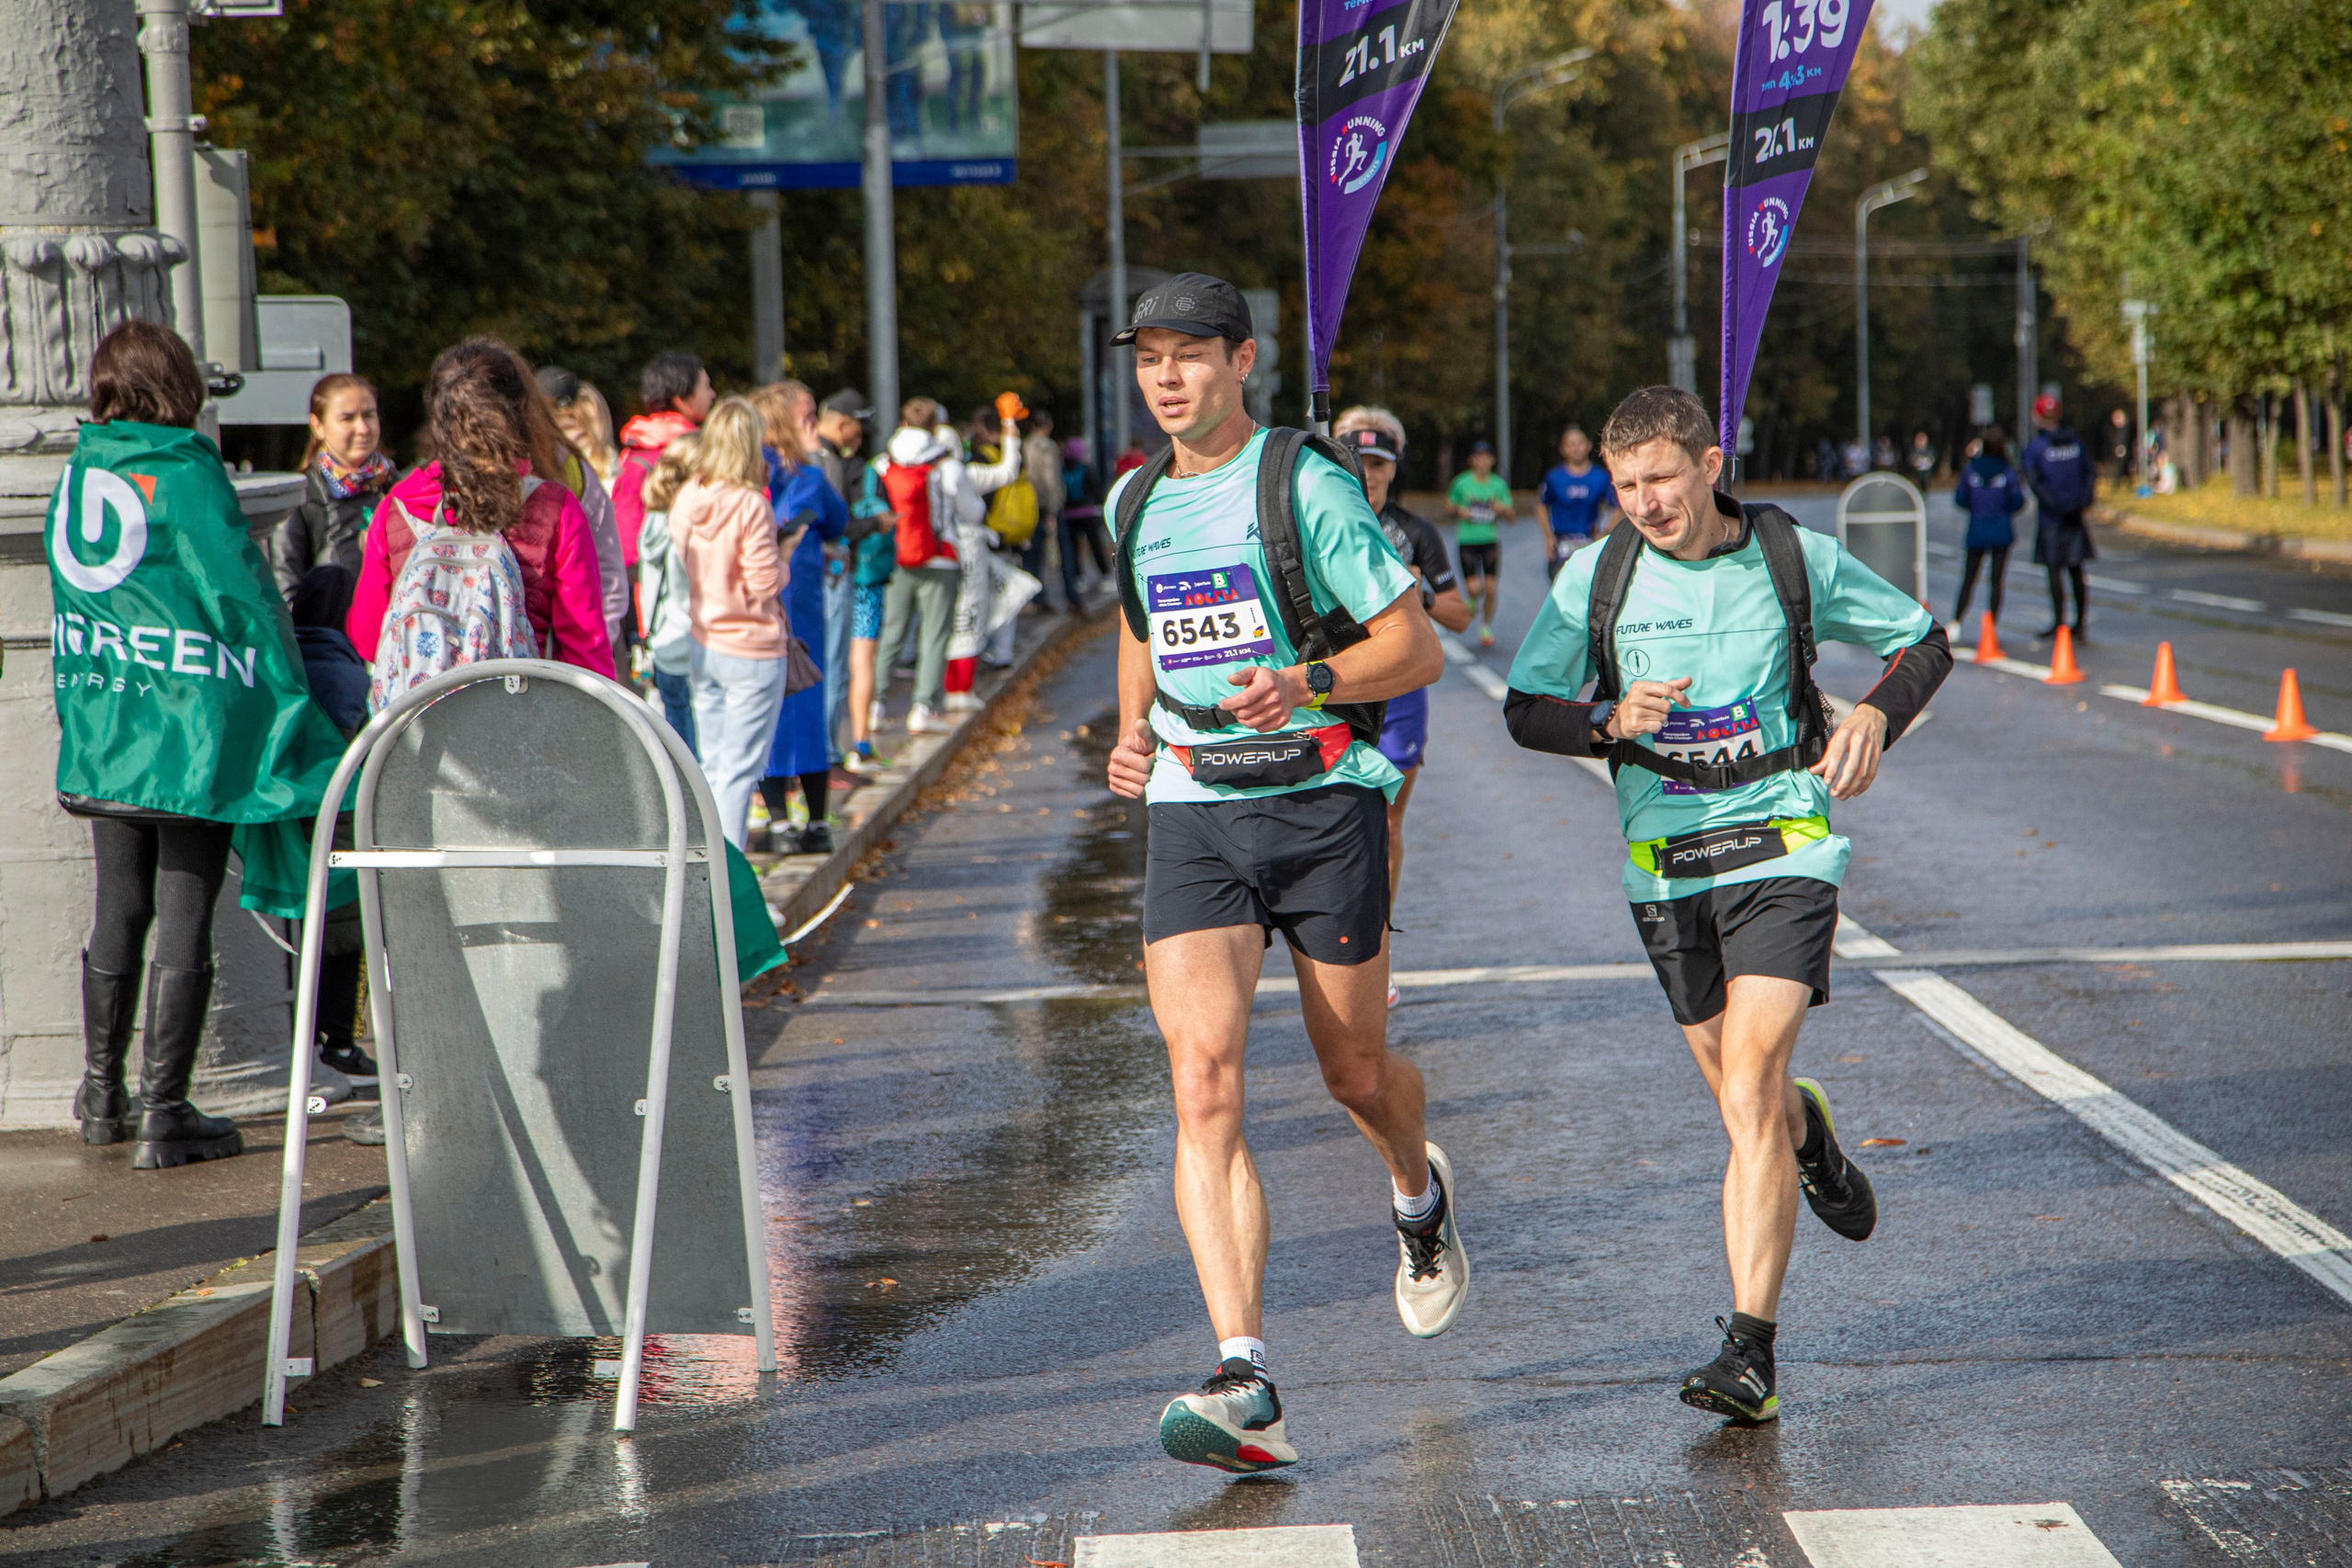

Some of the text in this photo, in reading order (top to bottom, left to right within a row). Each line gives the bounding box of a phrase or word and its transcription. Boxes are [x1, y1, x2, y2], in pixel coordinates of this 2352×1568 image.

[1339, 24, 1396, 87] 21.1
[1341, 116, 1386, 138] RUNNING
[1758, 197, 1790, 220] RUNNING
[1162, 612, 1241, 647] 6543
[1616, 618, 1692, 635] FUTURE WAVES
[1201, 749, 1302, 766] POWERUP
[1672, 837, 1762, 864] POWERUP
